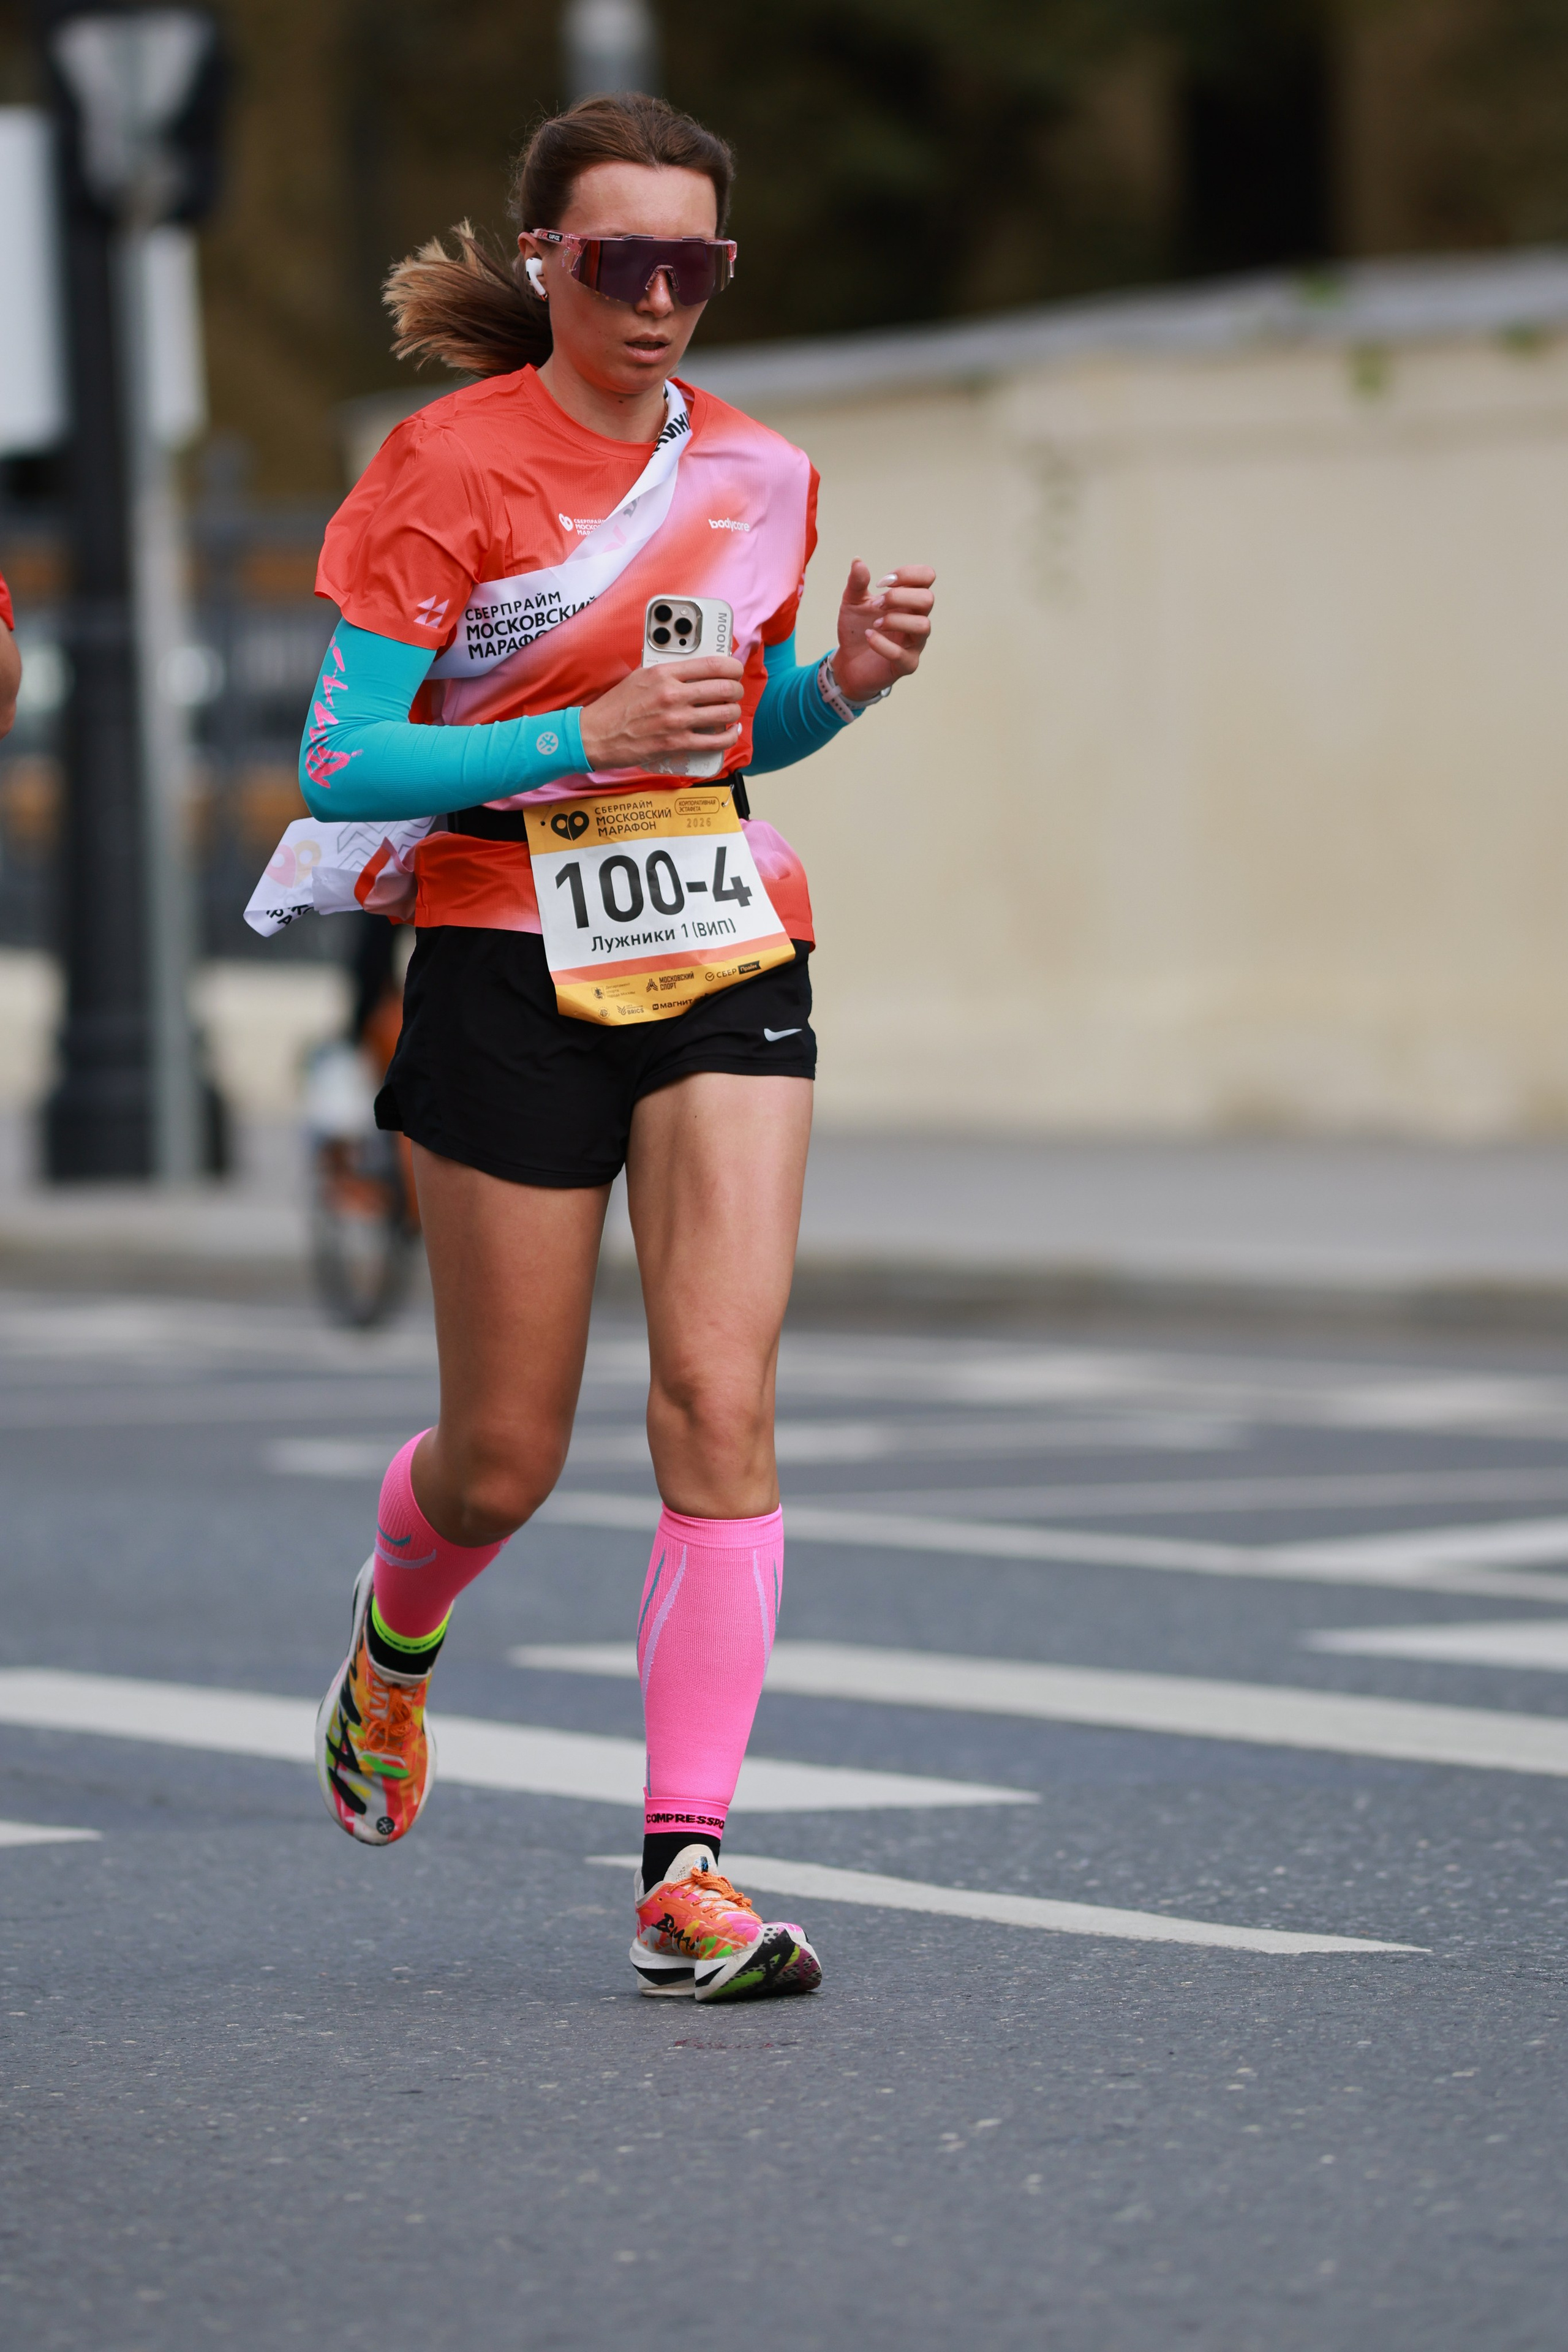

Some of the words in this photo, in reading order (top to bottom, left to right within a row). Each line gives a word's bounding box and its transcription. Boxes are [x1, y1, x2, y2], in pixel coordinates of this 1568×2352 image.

[708, 517, 750, 532] bodycore
[466, 591, 562, 621] СБЕРПРАЙМ
[716, 612, 727, 653] MOON
[595, 800, 653, 815] СБЕРПРАЙМ
[596, 807, 671, 826] МОСКОВСКИЙ
[687, 818, 712, 828] 2026
[598, 821, 657, 837] МАРАФОН
[556, 846, 753, 929] 100-4
[592, 929, 676, 953] Лужники
[681, 924, 688, 938] 1
[692, 918, 736, 938] (ВИП)
[659, 971, 694, 983] МОСКОВСКИЙ
[717, 968, 736, 978] СБЕР
[660, 982, 676, 990] СПОРТ
[646, 1813, 725, 1830] COMPRESSPO
